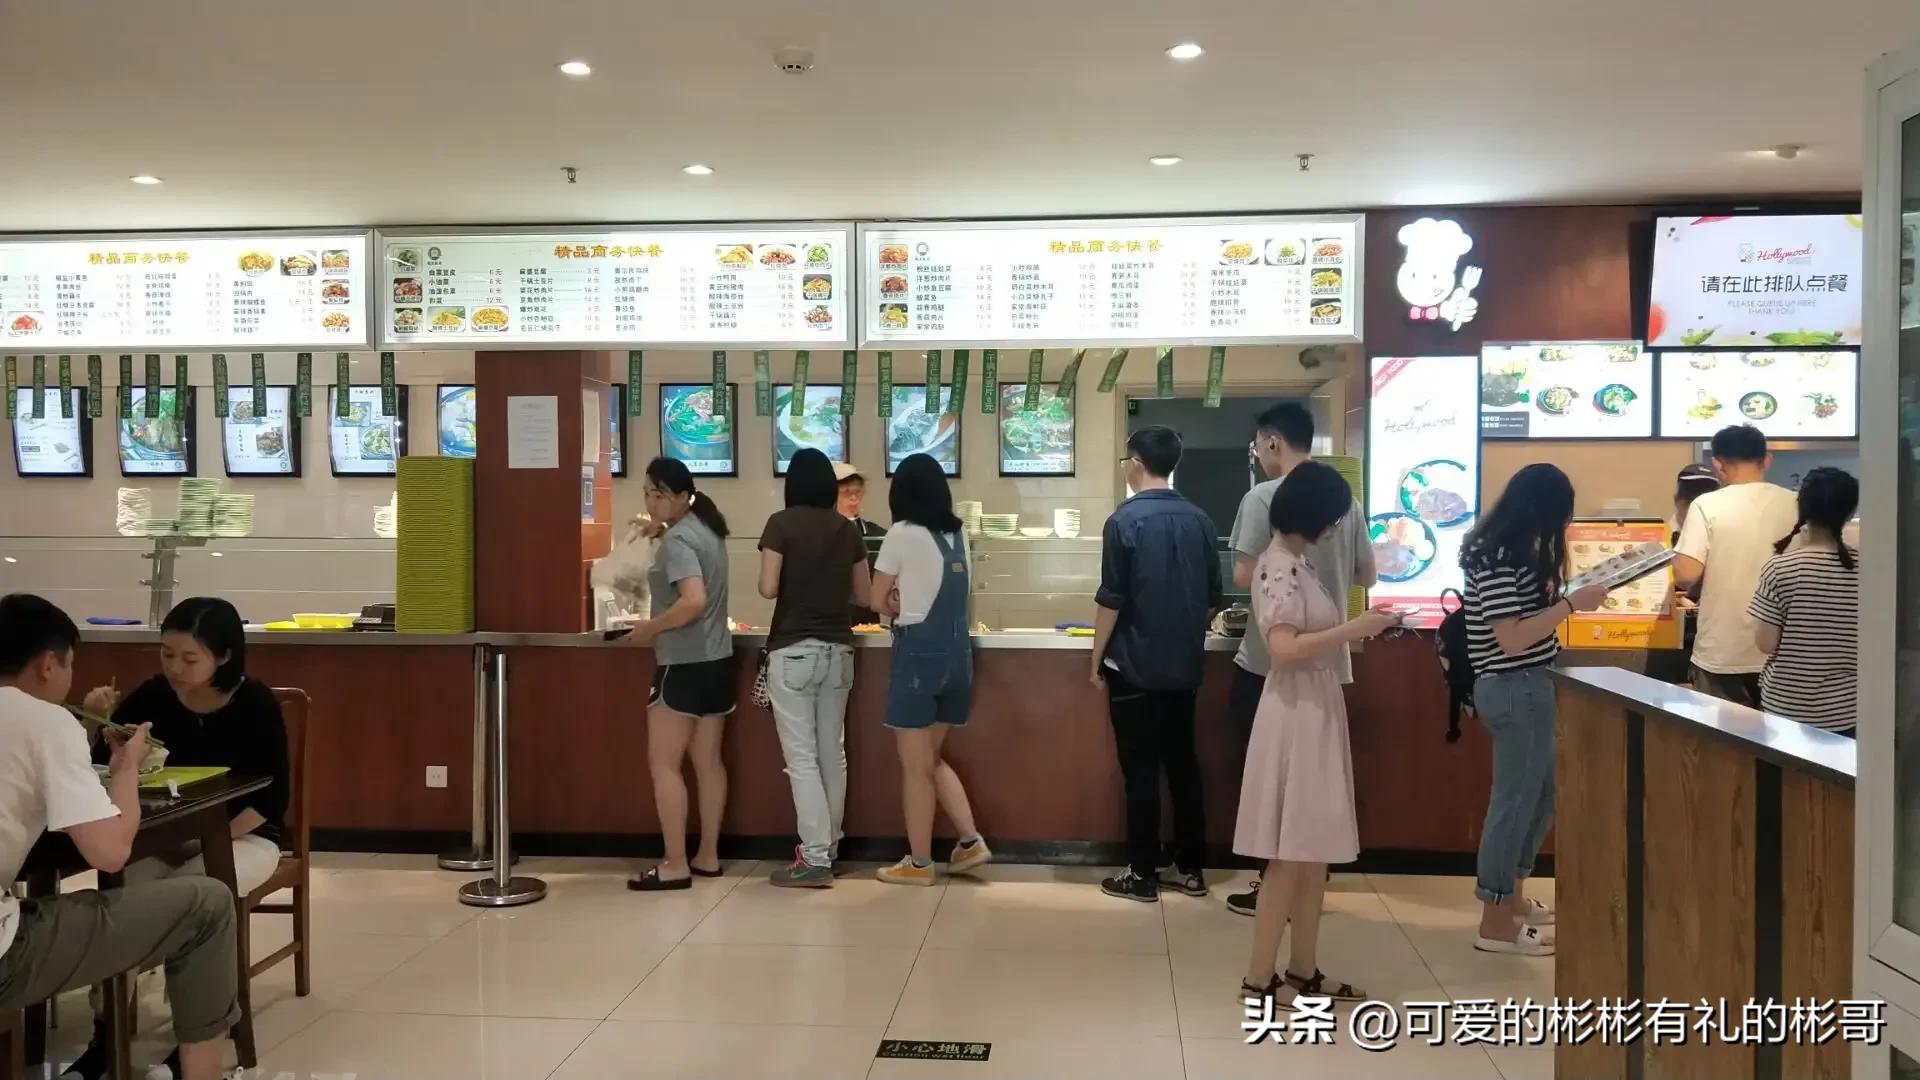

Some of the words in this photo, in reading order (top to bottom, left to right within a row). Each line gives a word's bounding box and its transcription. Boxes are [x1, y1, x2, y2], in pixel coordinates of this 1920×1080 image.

[1048, 238, 1164, 254] 精品商务快餐
[554, 243, 664, 259] 精品商务快餐
[1757, 244, 1814, 263] Hollywood
[519, 267, 547, 275] 麻婆豆腐
[429, 278, 449, 286] 小油菜
[520, 277, 554, 285] 干锅土豆片
[916, 274, 951, 283] 洋葱炒肉片
[1210, 279, 1248, 287] 干锅娃娃菜
[1701, 274, 1849, 293] 请在此排队点餐
[1211, 289, 1240, 297] 小炒木耳
[520, 296, 554, 304] 豆角炒肉片
[1728, 300, 1755, 308] PLEASE
[708, 302, 744, 310] 酸辣土豆丝
[1748, 308, 1772, 316] THANK
[887, 1041, 987, 1055] 小心地滑
